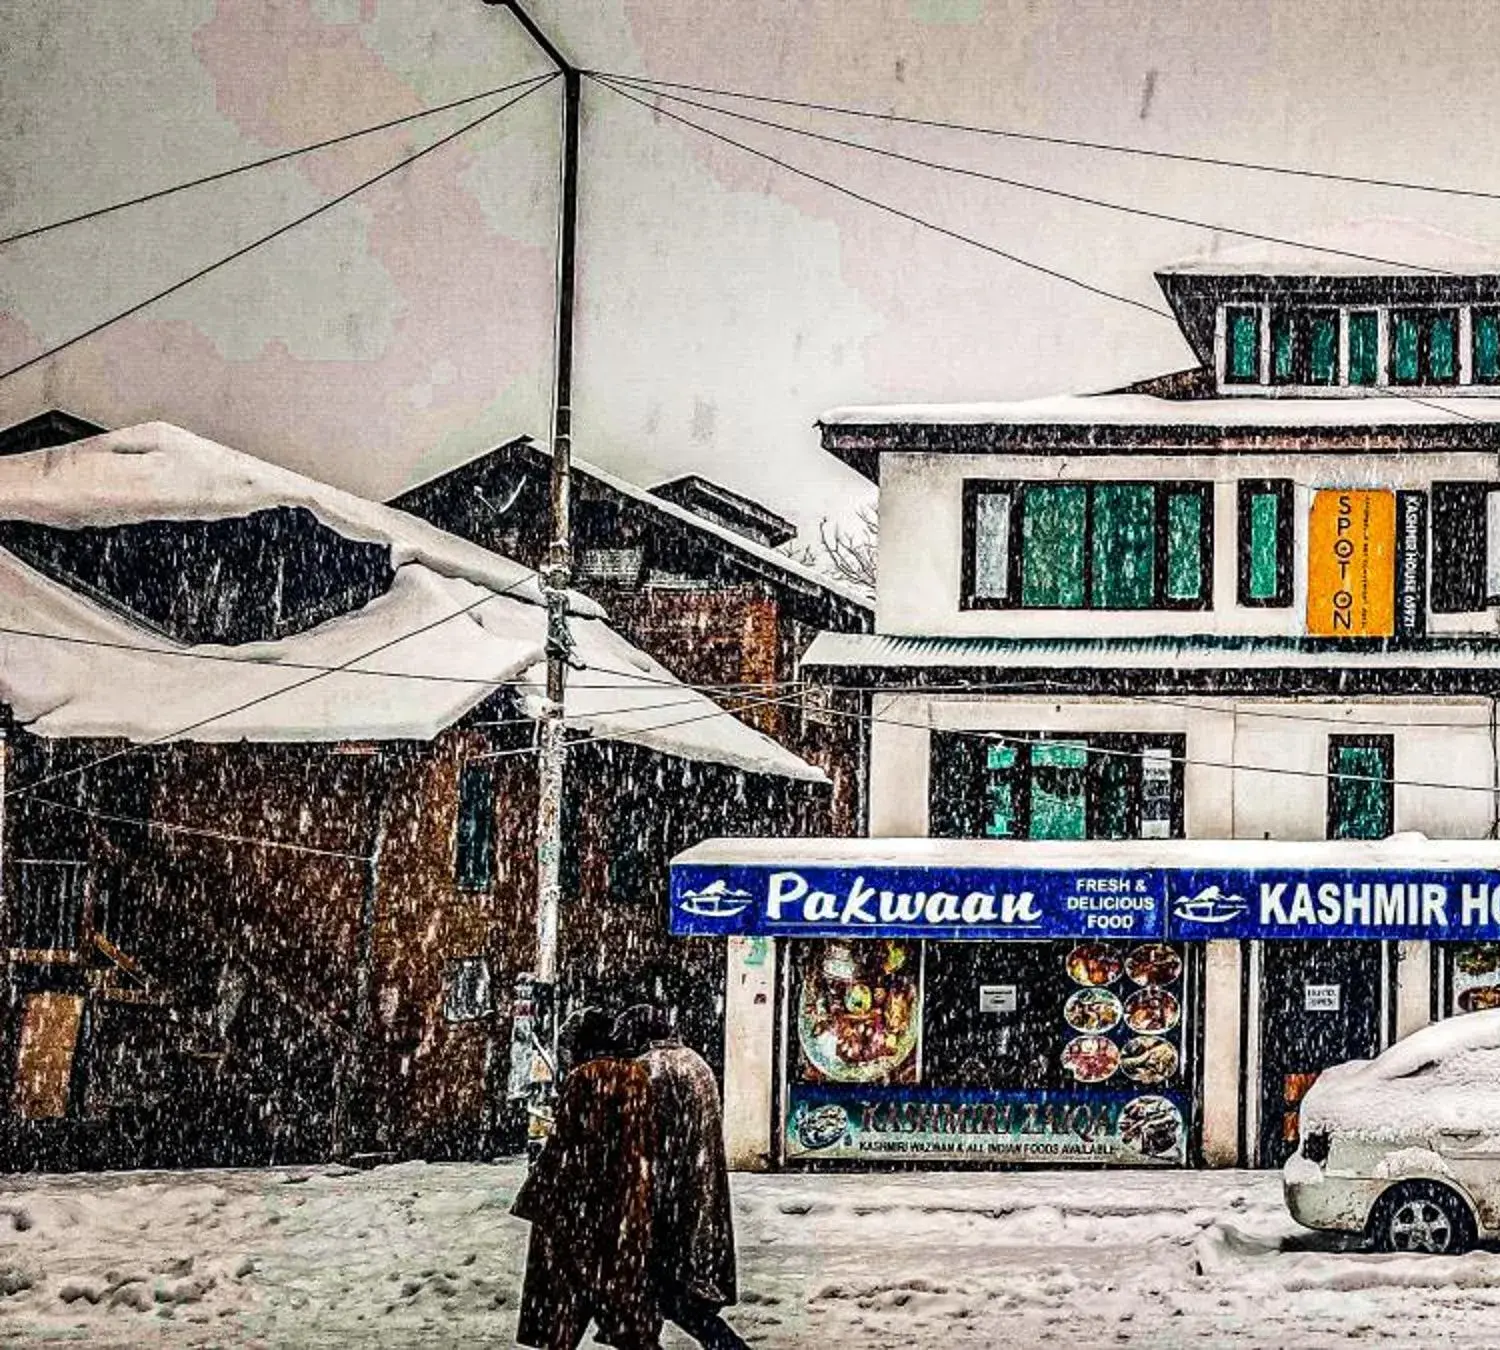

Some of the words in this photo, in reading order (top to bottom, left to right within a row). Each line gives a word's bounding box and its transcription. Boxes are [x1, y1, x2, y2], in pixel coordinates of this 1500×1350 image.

[1405, 496, 1420, 550] KASHMIR
[1404, 552, 1417, 593] HOUSE
[1333, 590, 1353, 630] ON
[766, 872, 1042, 923] Pakwaan
[1067, 896, 1155, 911] DELICIOUS
[1076, 878, 1130, 893] FRESH
[1134, 879, 1147, 892] &
[1260, 882, 1447, 926] KASHMIR
[1087, 914, 1134, 929] FOOD
